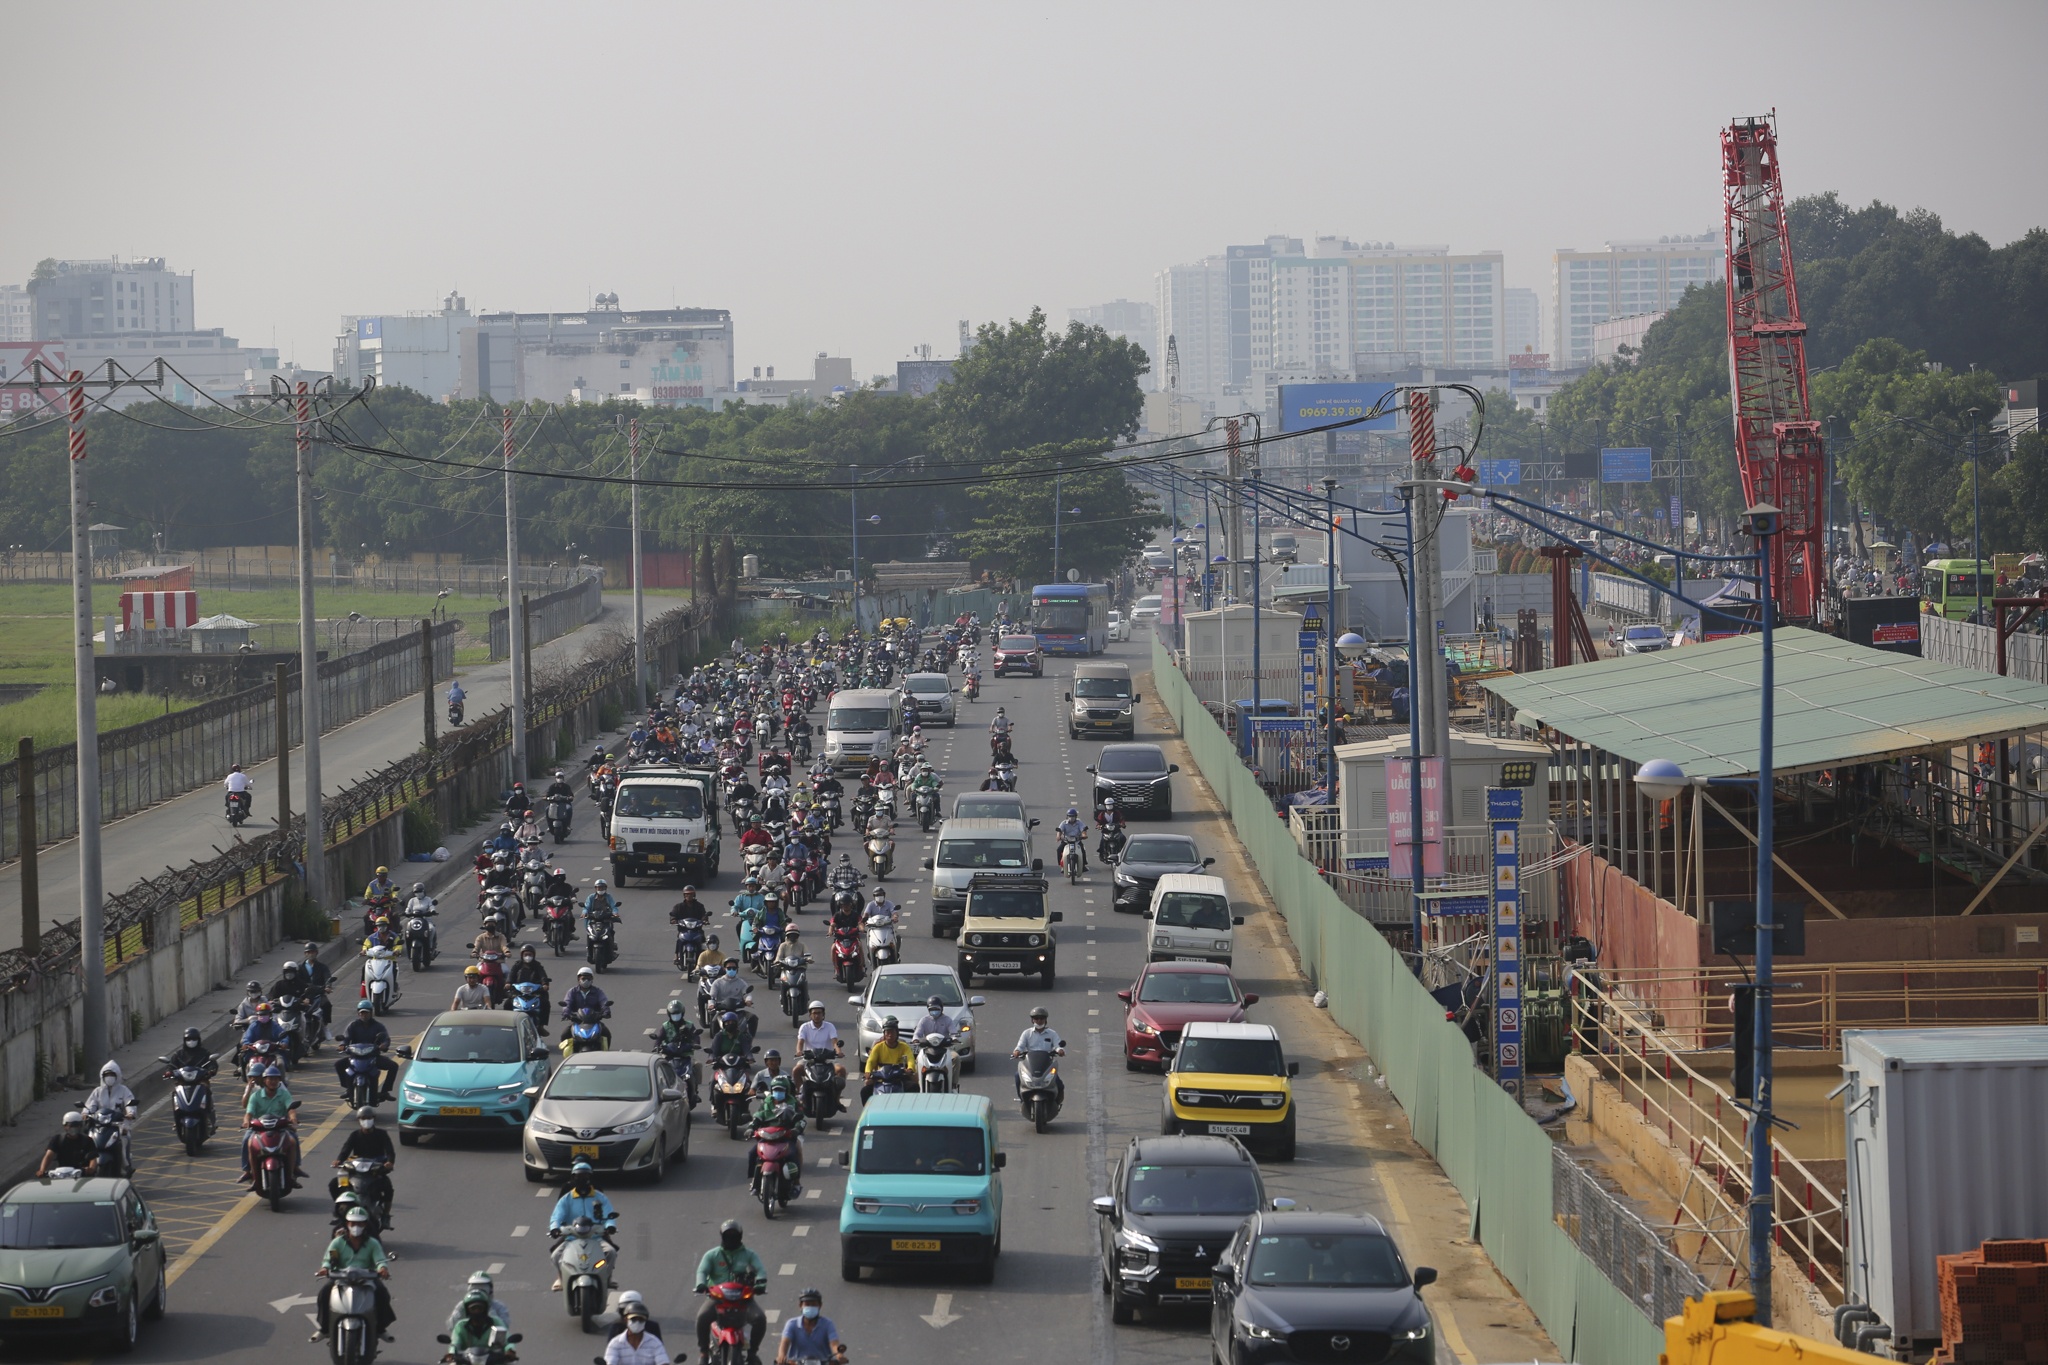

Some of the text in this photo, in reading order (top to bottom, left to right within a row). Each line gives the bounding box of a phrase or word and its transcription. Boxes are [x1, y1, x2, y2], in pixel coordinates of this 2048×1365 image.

[1300, 406, 1379, 417] 0969.39.89.8
[1212, 1126, 1247, 1134] 51L-645.48
[896, 1241, 937, 1249] 50E-825.35
